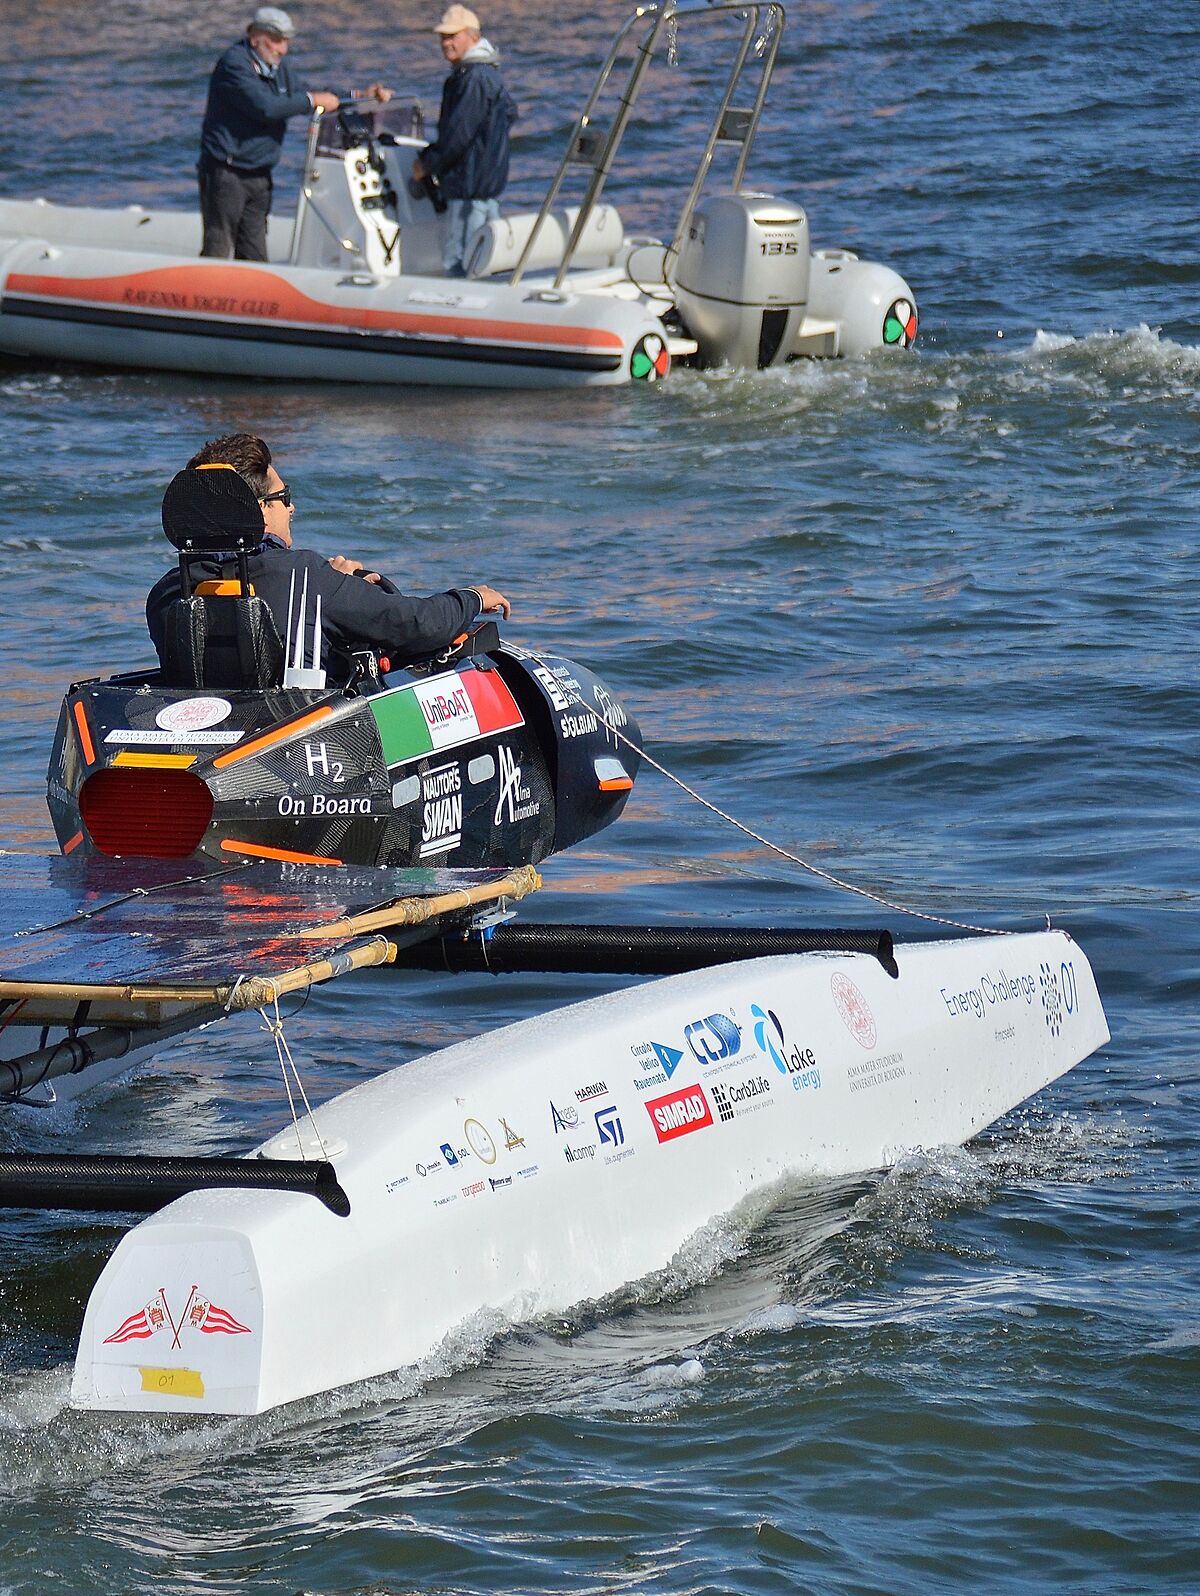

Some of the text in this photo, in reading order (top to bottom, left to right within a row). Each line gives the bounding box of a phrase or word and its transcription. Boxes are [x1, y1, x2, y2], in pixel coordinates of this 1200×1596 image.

[761, 242, 799, 256] 135
[124, 287, 280, 316] RAVENNA YACHT CLUB
[421, 689, 470, 725] UniBoAT
[423, 768, 461, 801] NAUTOR'S
[278, 795, 306, 816] On
[422, 794, 463, 842] SWAN
[940, 962, 1079, 1018] Energy Challenge 01
[631, 1042, 652, 1056] Circolo
[780, 1043, 815, 1073] Lake
[639, 1057, 660, 1071] Velico
[633, 1072, 667, 1091] Ravennate
[729, 1076, 770, 1103] Carb2Life
[792, 1069, 821, 1091] energy
[654, 1094, 706, 1133] SIMRAD
[457, 1148, 471, 1159] SOL
[158, 1375, 174, 1387] 01
